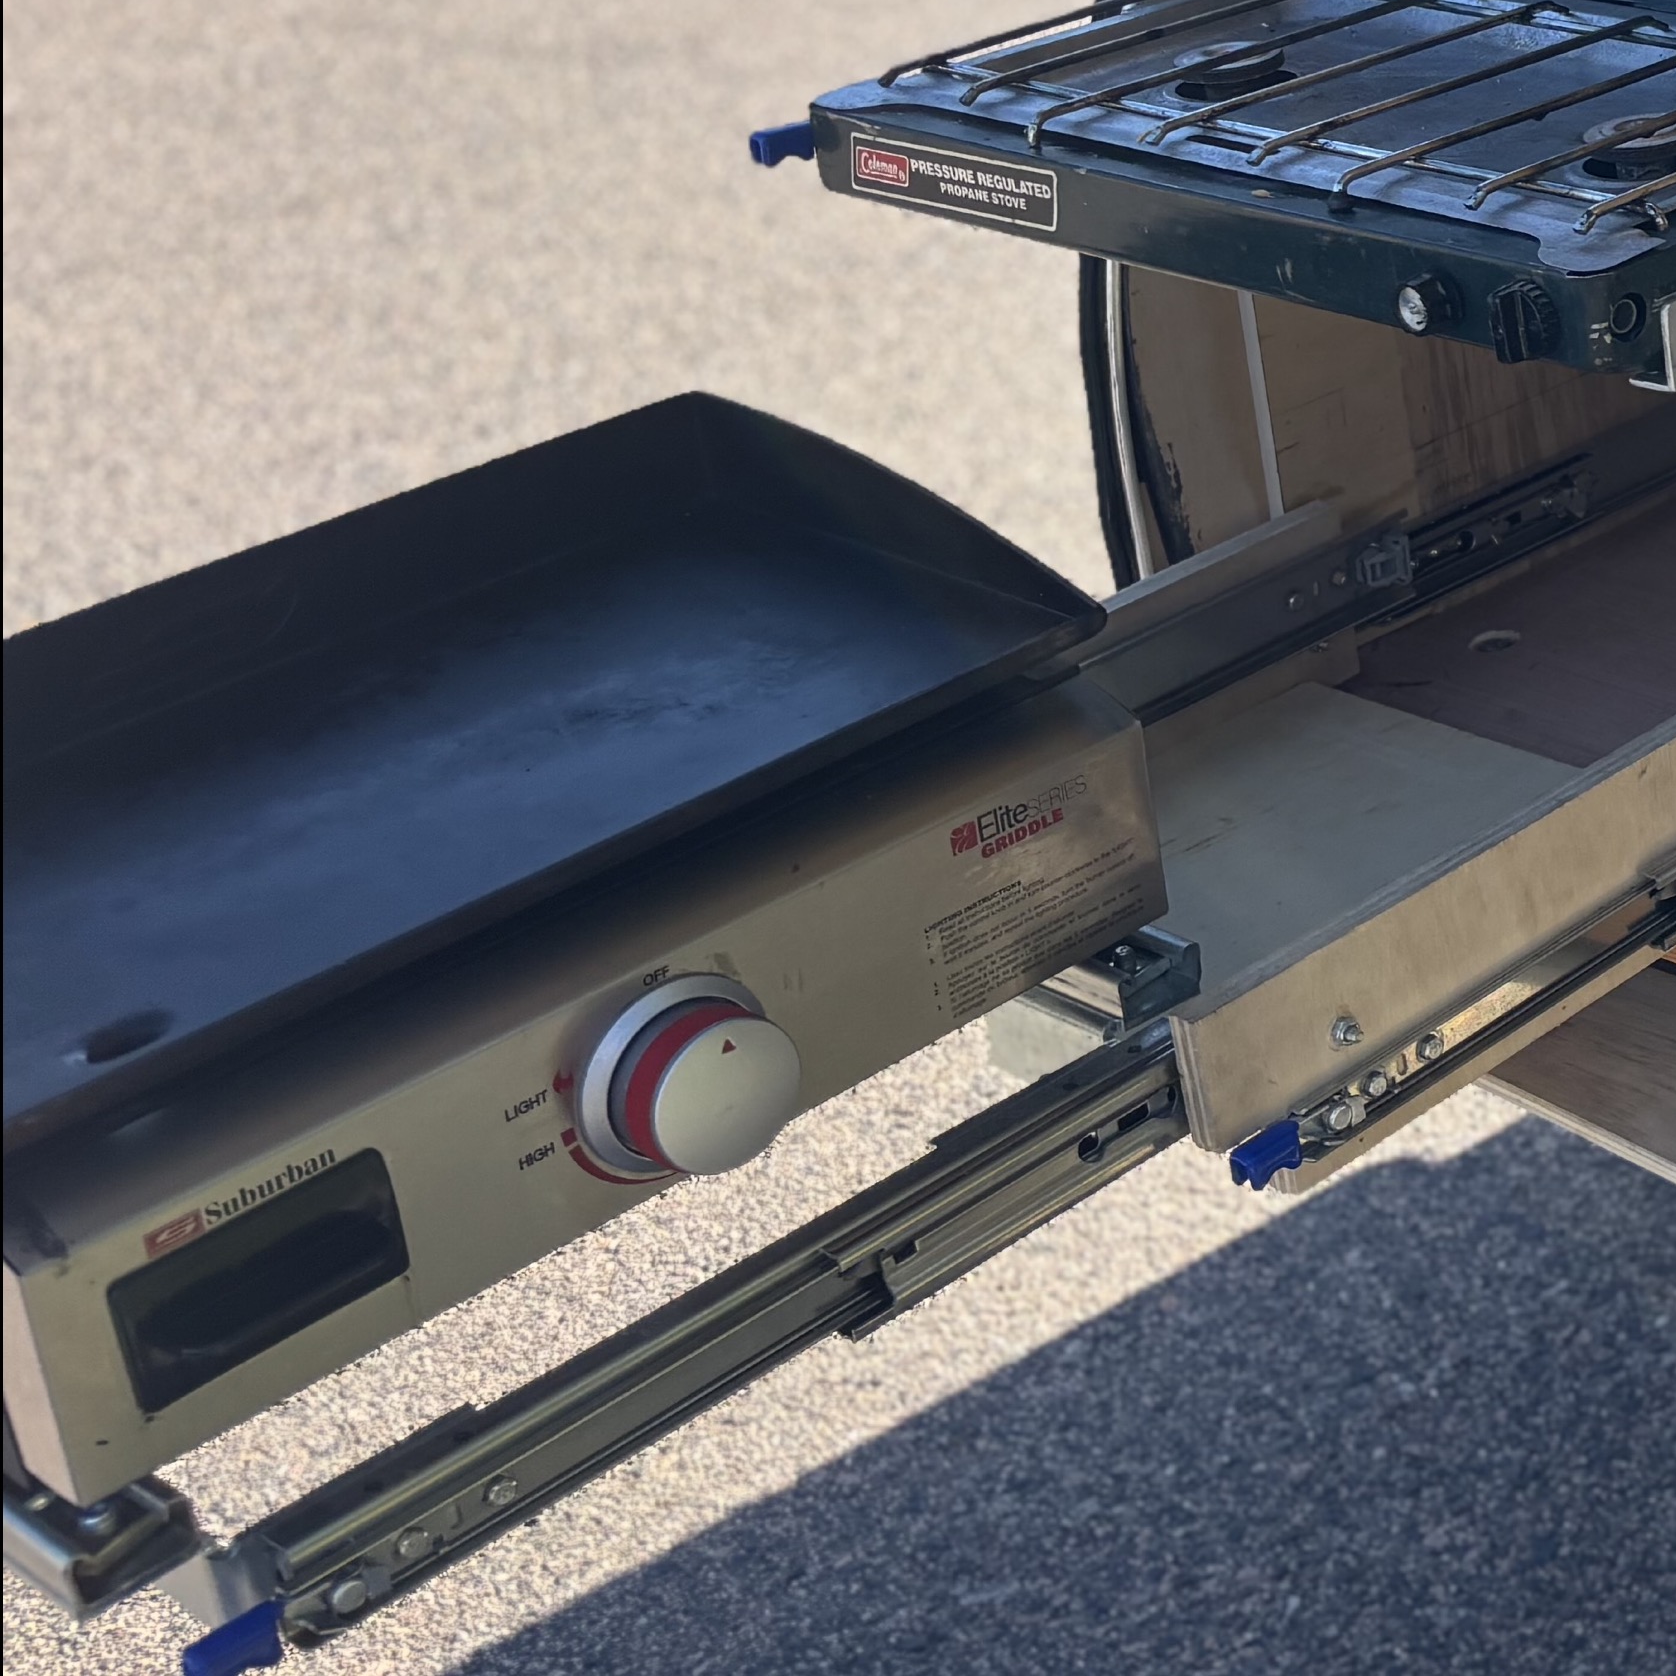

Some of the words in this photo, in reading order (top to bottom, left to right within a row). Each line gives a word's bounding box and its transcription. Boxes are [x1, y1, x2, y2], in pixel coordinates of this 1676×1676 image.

[861, 152, 898, 175] Coleman
[910, 158, 975, 184] PRESSURE
[976, 171, 1051, 199] REGULATED
[940, 182, 990, 203] PROPANE
[992, 191, 1027, 210] STOVE
[981, 808, 1064, 859] GRIDDLE
[642, 965, 671, 986] OFF
[504, 1088, 549, 1123] LIGHT
[518, 1141, 556, 1172] HIGH
[204, 1148, 337, 1226] Suburban
